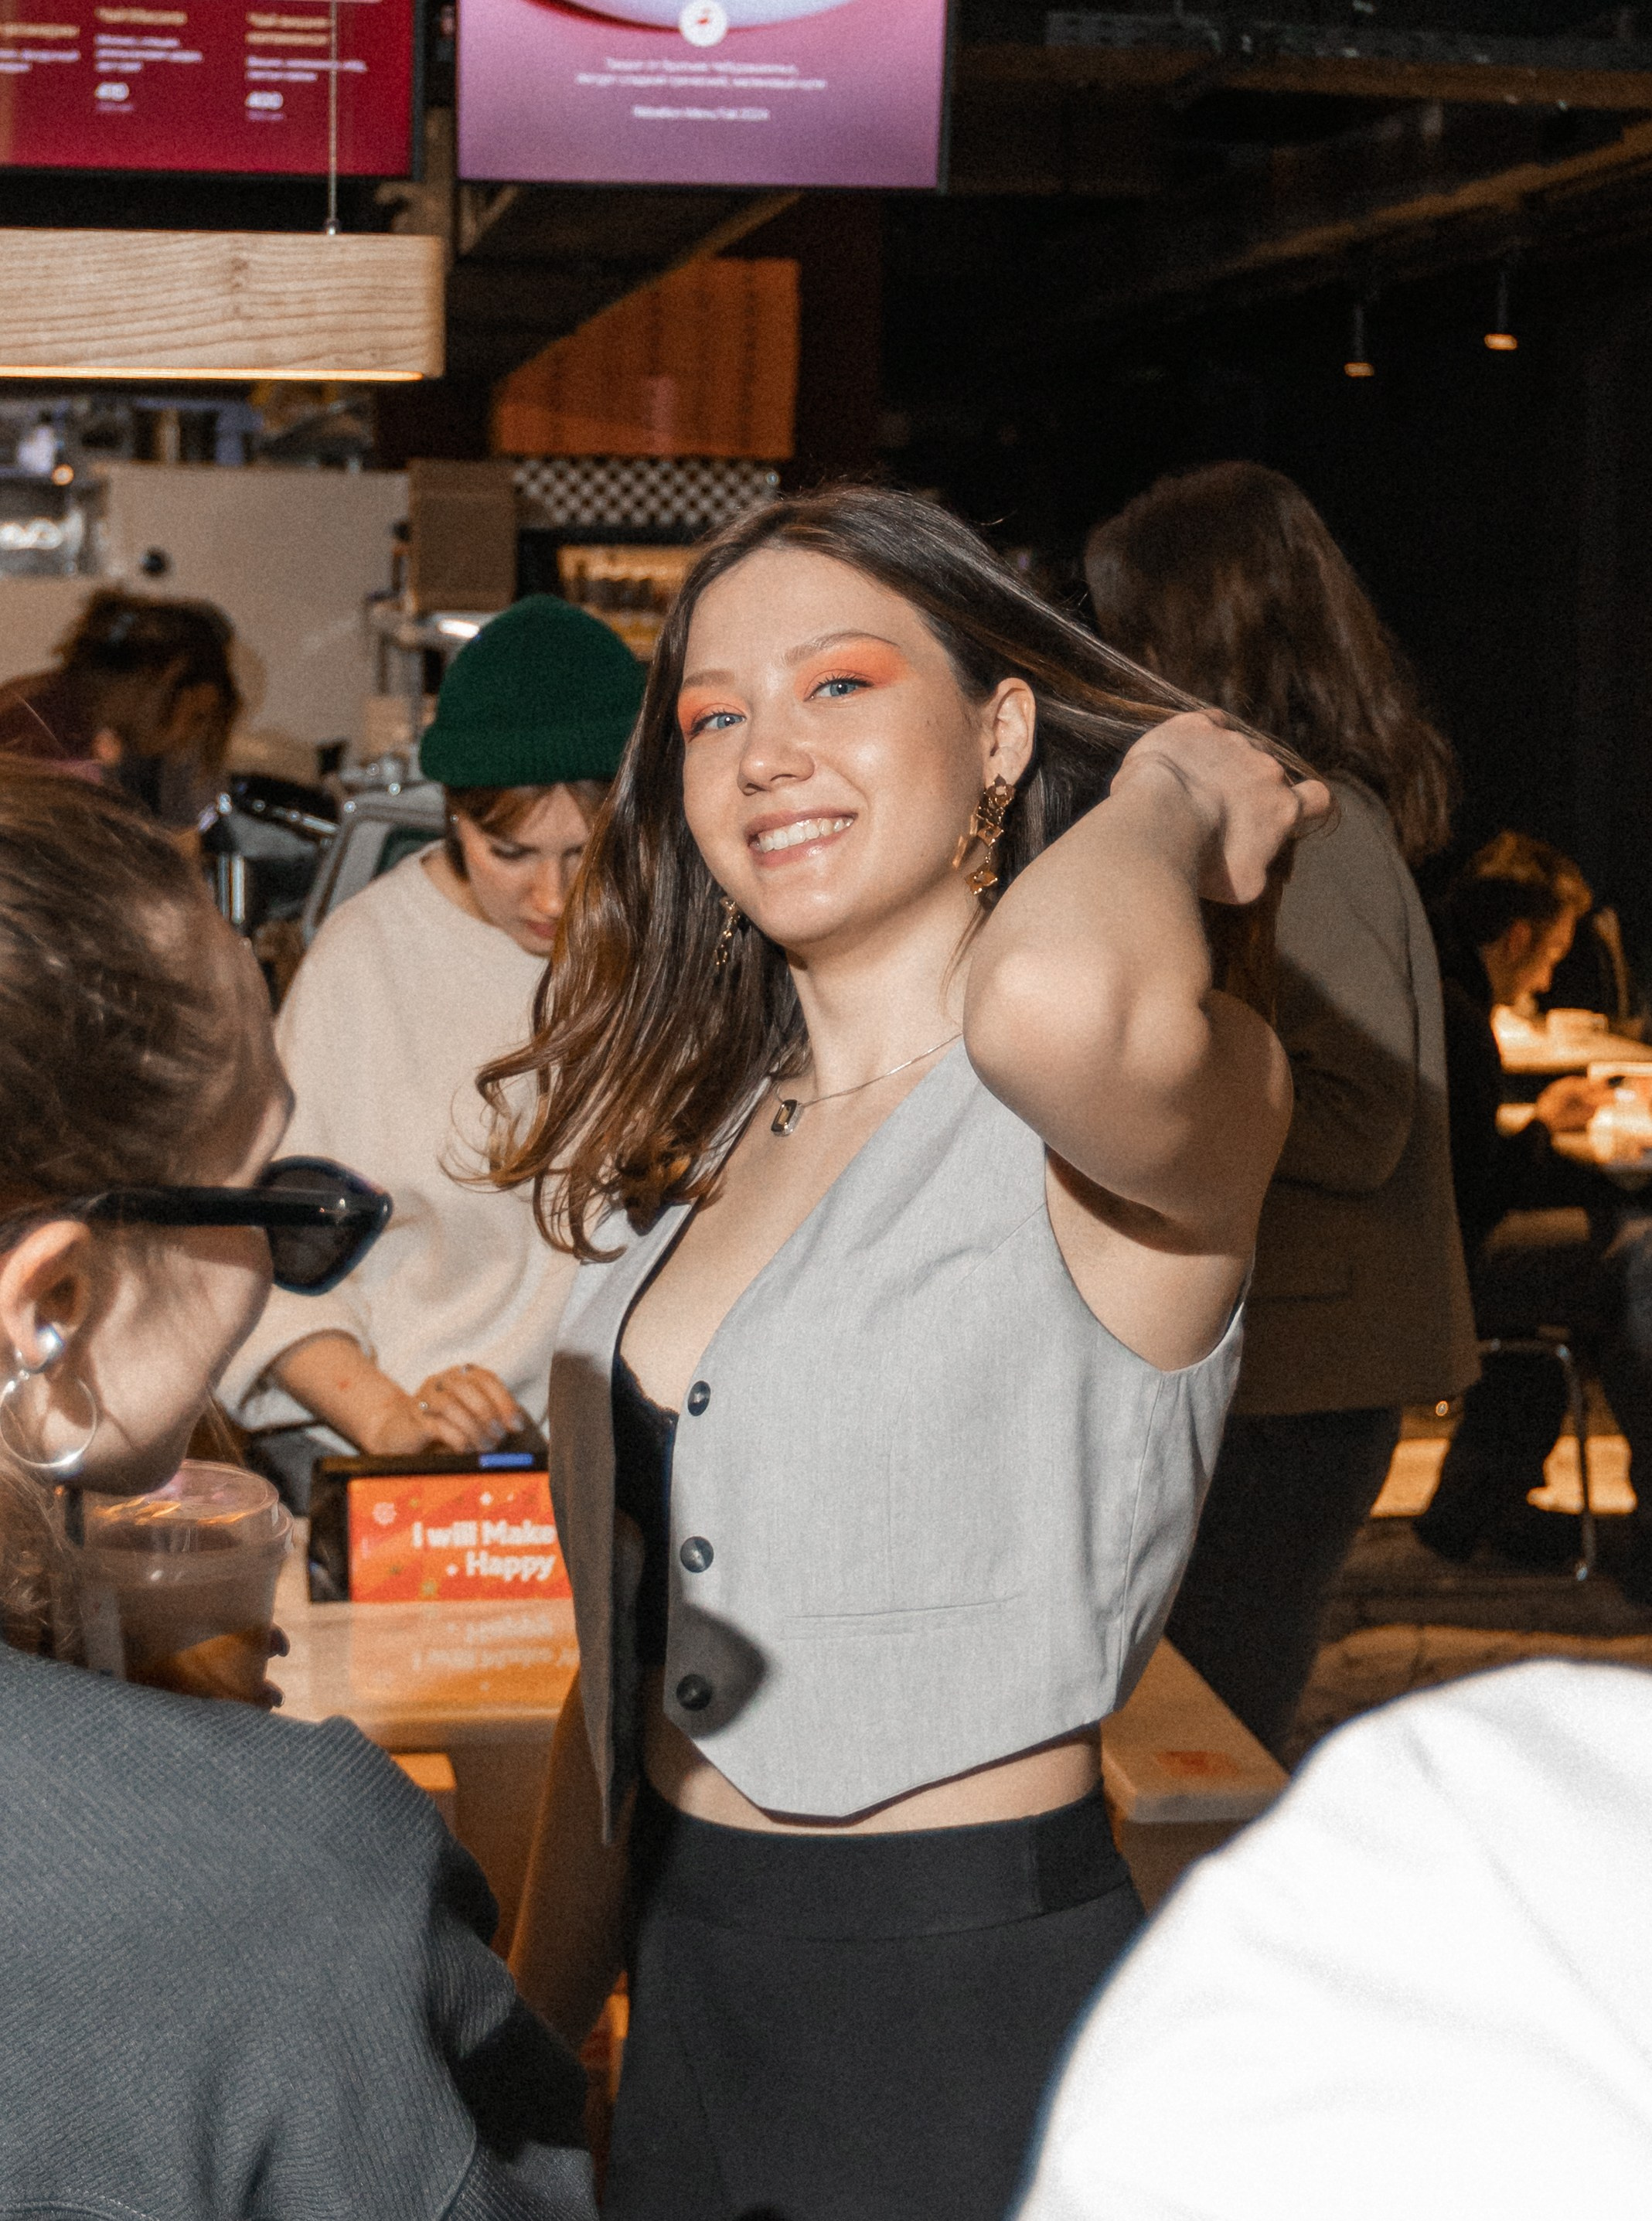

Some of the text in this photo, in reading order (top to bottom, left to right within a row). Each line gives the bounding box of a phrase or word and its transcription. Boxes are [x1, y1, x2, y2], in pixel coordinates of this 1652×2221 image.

[413, 1518, 556, 1548] I will Make
[465, 1549, 557, 1582] Happy
